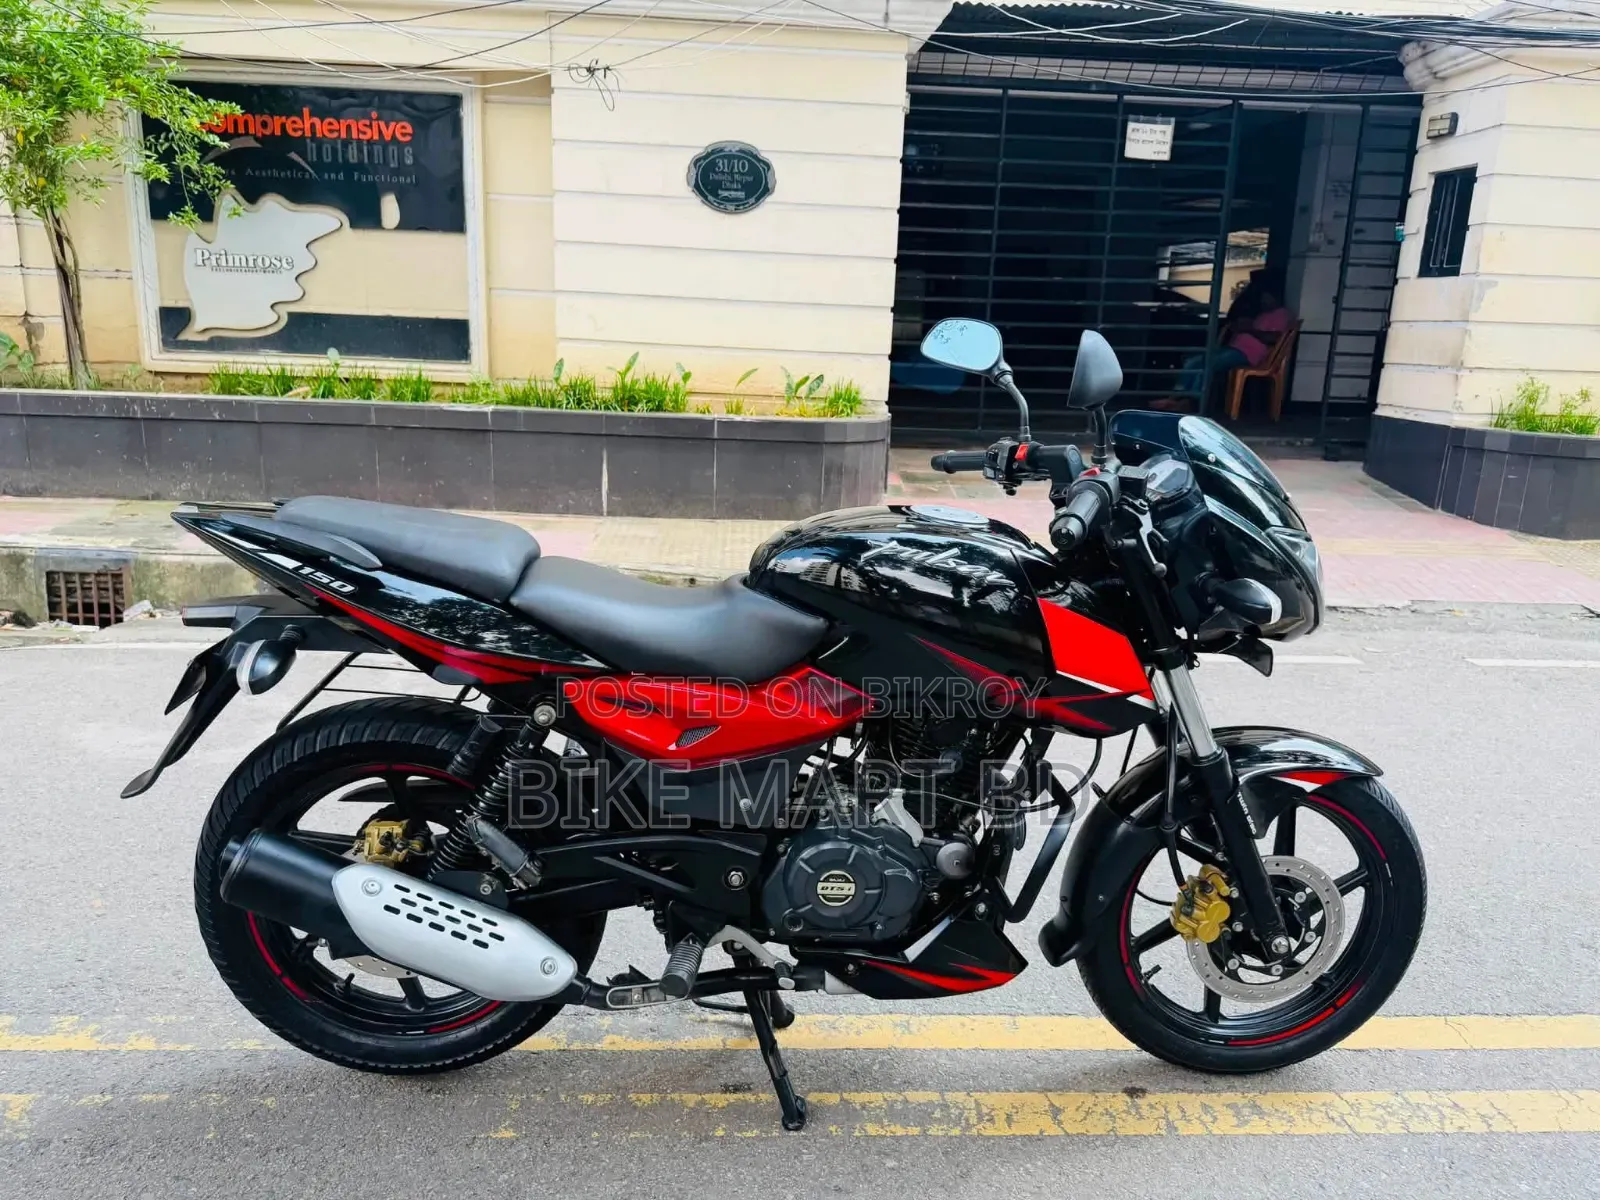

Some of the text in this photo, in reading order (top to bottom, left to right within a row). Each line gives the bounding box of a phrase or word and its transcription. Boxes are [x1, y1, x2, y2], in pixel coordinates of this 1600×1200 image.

[196, 105, 413, 143] omprehensive
[306, 138, 414, 168] holdings
[715, 158, 749, 173] 31/10
[323, 171, 344, 181] and
[353, 171, 416, 184] Functional
[194, 248, 294, 271] Primrose
[299, 566, 355, 593] 150
